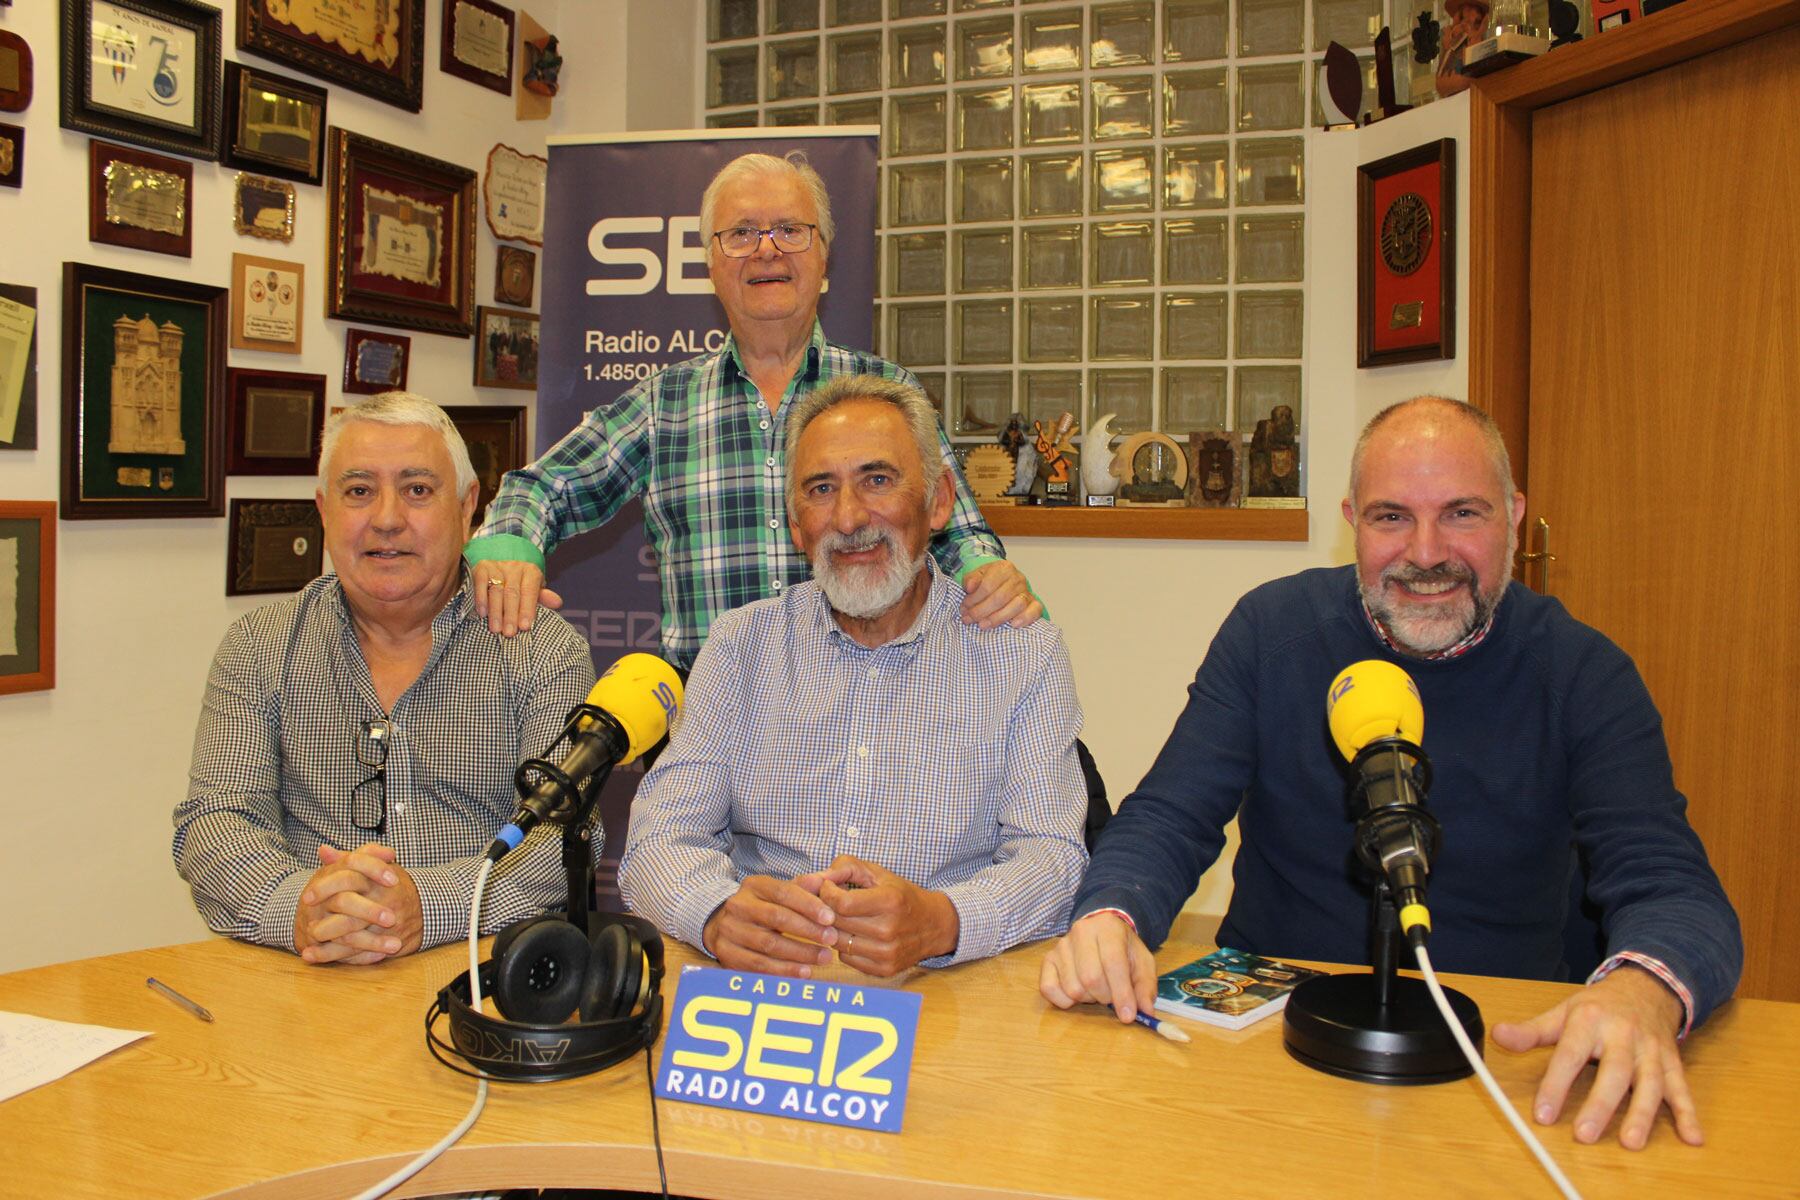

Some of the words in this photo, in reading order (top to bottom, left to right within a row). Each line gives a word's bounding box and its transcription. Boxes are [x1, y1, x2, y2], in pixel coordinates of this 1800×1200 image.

[585, 330, 661, 353] Radio
[668, 329, 726, 353] ALC
[651, 682, 677, 728] SE
[729, 976, 865, 1007] CADENA
[672, 995, 898, 1096] SER
[666, 1070, 765, 1106] RADIO
[780, 1087, 889, 1124] ALCOY
